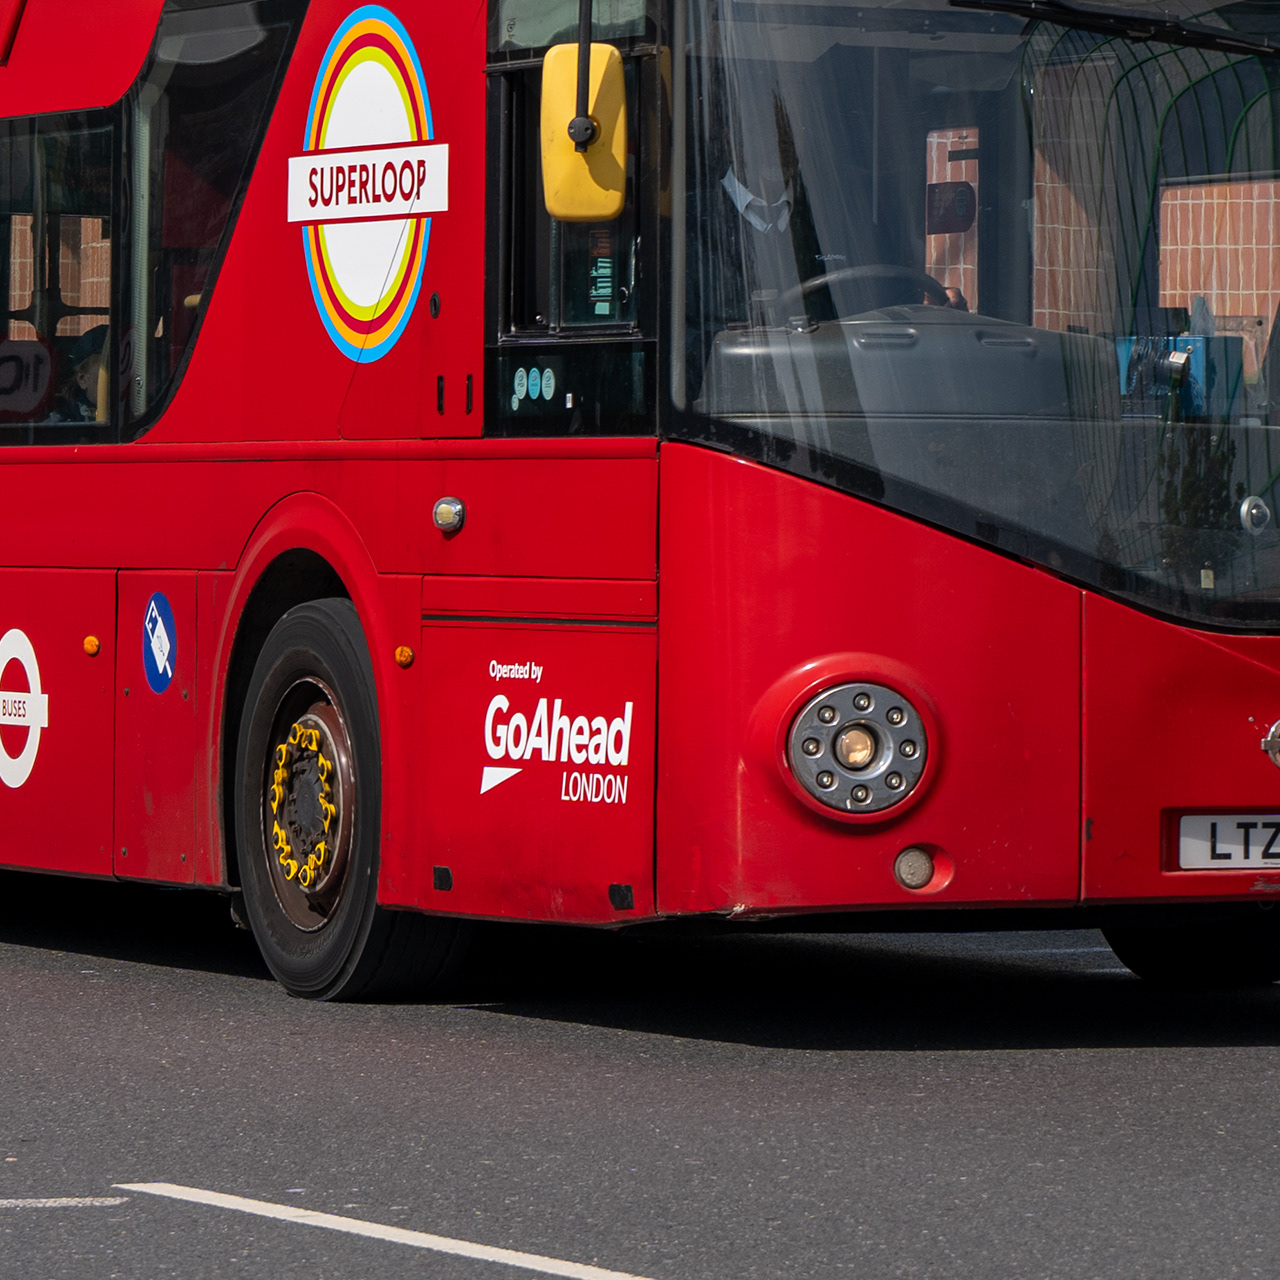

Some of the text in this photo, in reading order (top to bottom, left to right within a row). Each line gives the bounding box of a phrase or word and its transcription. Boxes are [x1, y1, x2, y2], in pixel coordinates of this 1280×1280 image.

[308, 158, 427, 208] SUPERLOOP
[489, 659, 543, 683] Operated by
[2, 699, 27, 718] BUSES
[484, 694, 634, 766] GoAhead
[561, 771, 629, 804] LONDON
